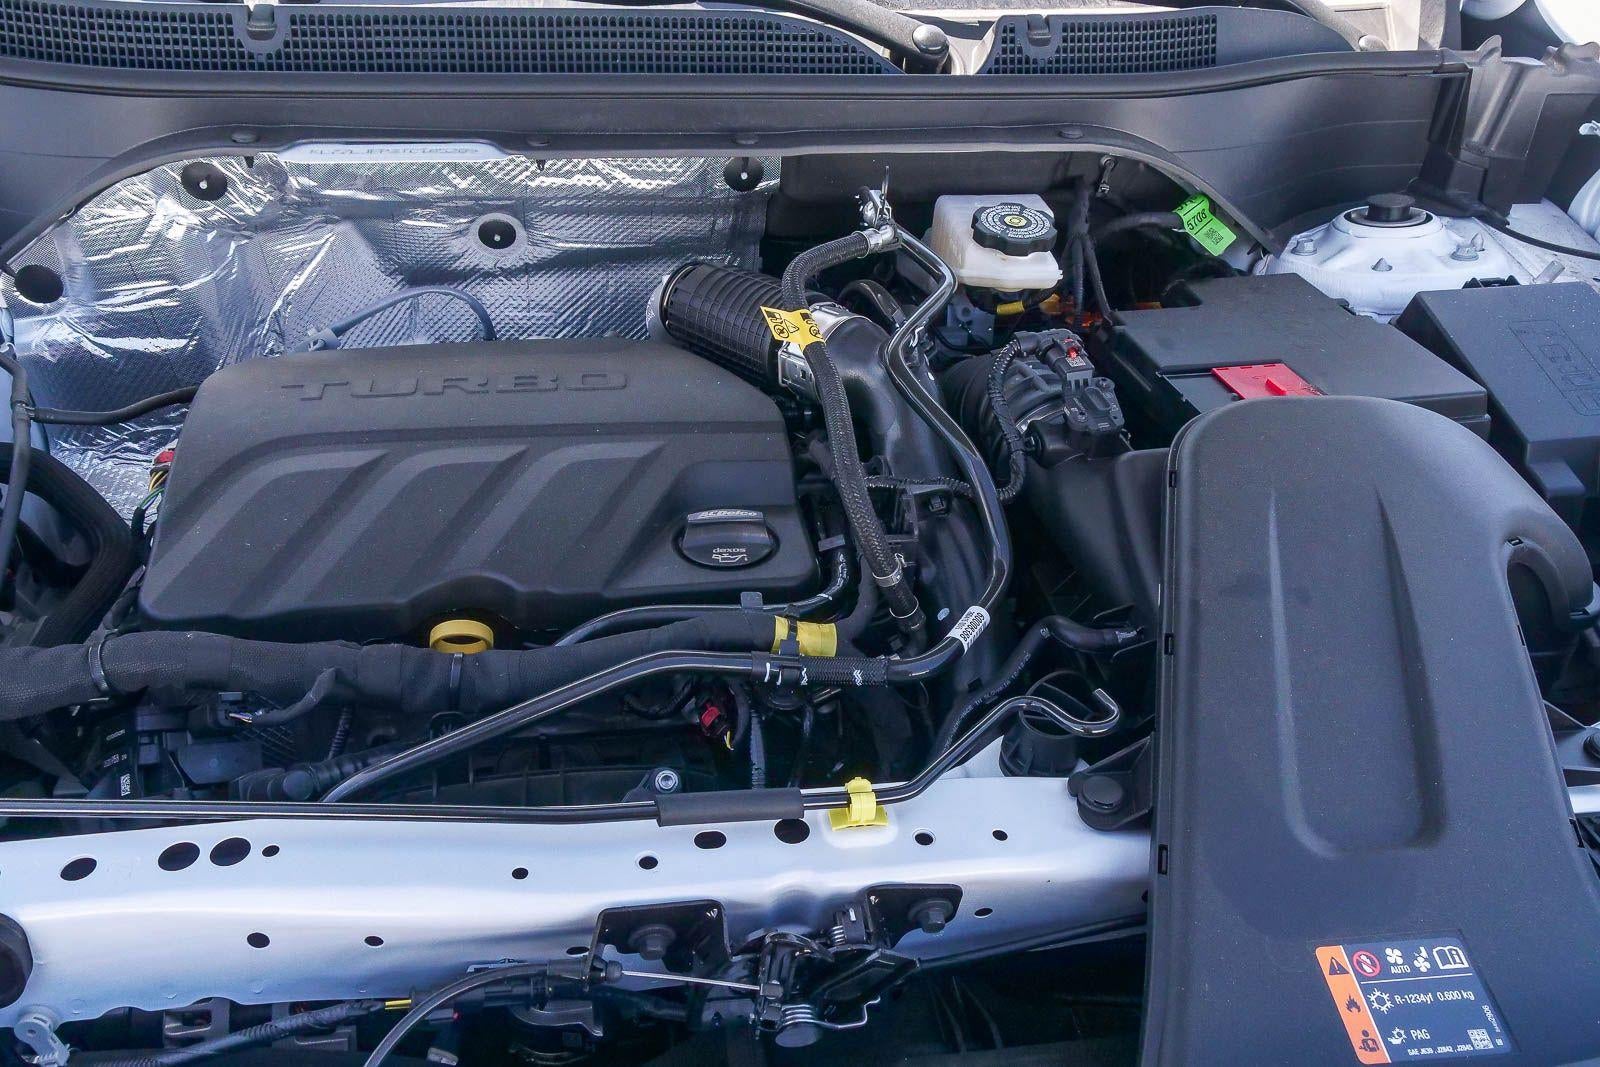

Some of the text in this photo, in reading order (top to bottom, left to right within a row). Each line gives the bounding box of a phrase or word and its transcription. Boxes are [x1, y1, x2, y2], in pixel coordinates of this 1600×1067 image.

[280, 373, 628, 400] TURBO
[1390, 965, 1411, 974] AUTO
[1394, 990, 1475, 1006] R-1234yf 0.600 kg
[1410, 1028, 1431, 1041] PAG
